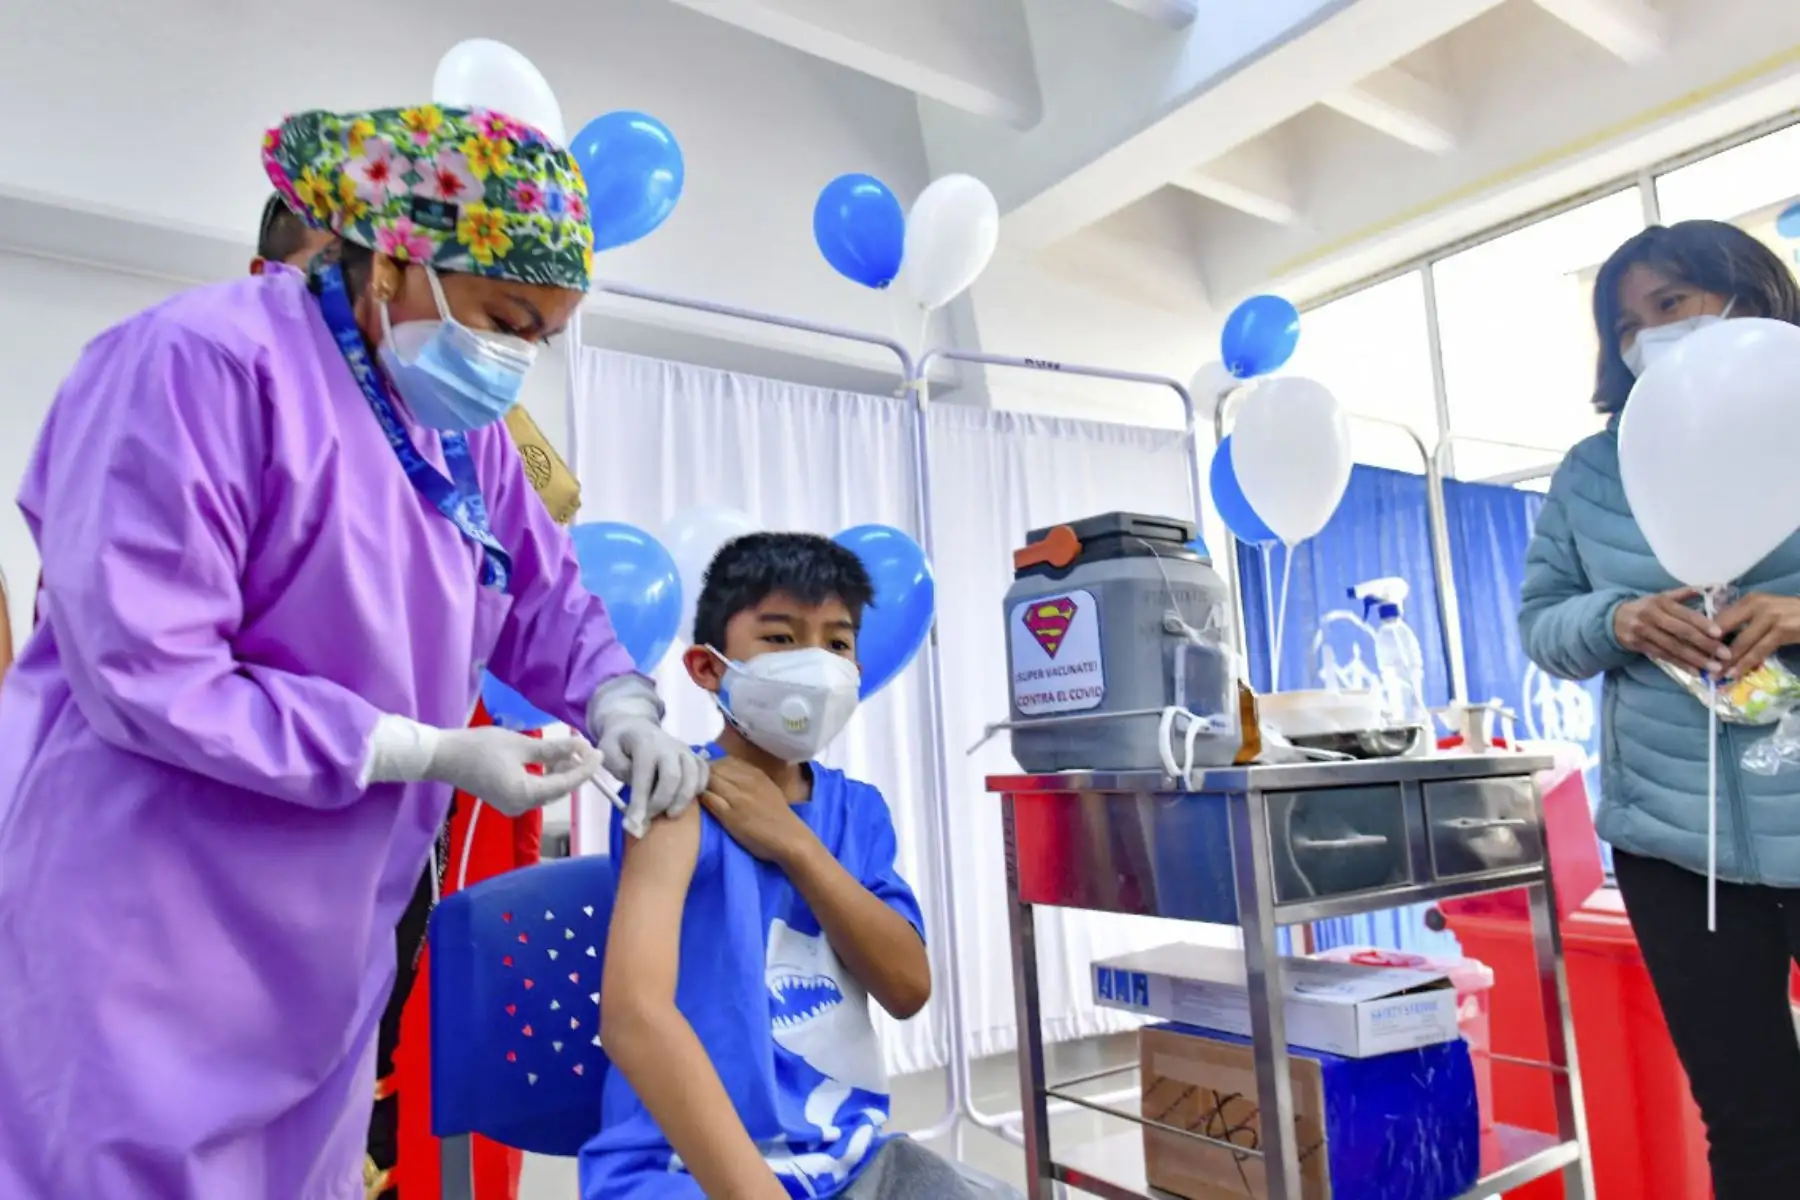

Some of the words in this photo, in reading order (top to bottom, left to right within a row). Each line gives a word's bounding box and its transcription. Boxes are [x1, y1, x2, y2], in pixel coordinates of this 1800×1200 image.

[1016, 691, 1056, 707] CONTRA
[1057, 690, 1068, 702] EL
[1069, 686, 1103, 701] COVID
